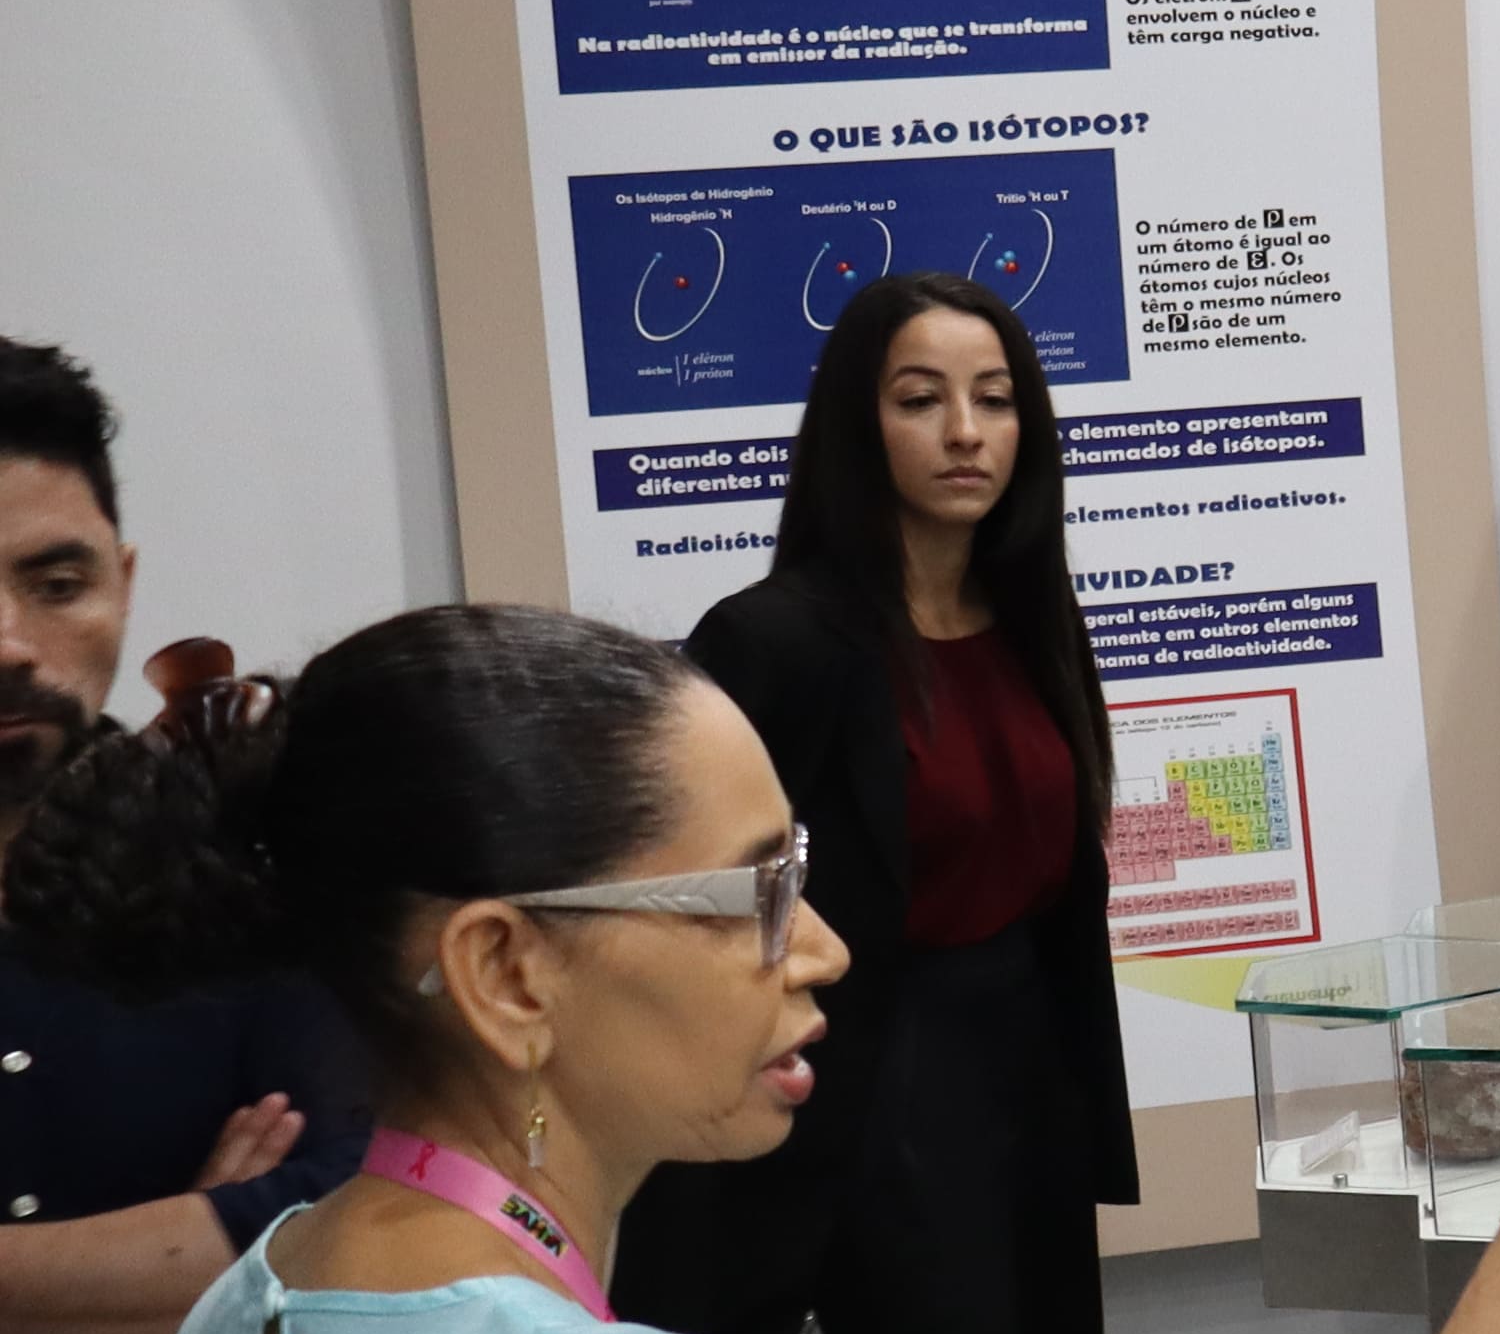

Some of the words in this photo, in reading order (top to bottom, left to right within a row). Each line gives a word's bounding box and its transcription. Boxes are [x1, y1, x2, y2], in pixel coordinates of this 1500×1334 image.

[1126, 8, 1217, 25] envolvem
[1223, 10, 1234, 21] o
[1240, 3, 1300, 20] núcleo
[1305, 6, 1316, 18] e
[577, 36, 612, 53] Na
[617, 29, 783, 52] radioatividade
[787, 27, 801, 44] é
[805, 30, 819, 43] o
[823, 24, 894, 42] núcleo
[898, 25, 939, 41] que
[943, 24, 965, 38] se
[968, 16, 1087, 36] transforma
[1127, 28, 1164, 45] têm
[1170, 30, 1224, 44] carga
[1229, 23, 1319, 42] negativa.
[707, 52, 741, 65] em
[746, 46, 826, 64] emissor
[830, 43, 860, 60] da
[864, 39, 967, 59] radiação.
[772, 129, 799, 152] O
[808, 125, 882, 153] QUE
[891, 118, 958, 147] SÃO
[968, 111, 1149, 142] ISÓTOPOS?
[615, 193, 633, 205] Os
[634, 192, 688, 204] Isótopos
[689, 189, 706, 201] de
[707, 185, 774, 200] Hidrogênio
[650, 209, 717, 224] Hidrogênio
[800, 202, 852, 215] Deutério
[1135, 219, 1151, 235] O
[1156, 218, 1229, 234] número
[1234, 214, 1257, 230] de
[1288, 215, 1316, 227] em
[1136, 243, 1167, 255] um
[1173, 237, 1234, 253] átomo
[1239, 235, 1249, 249] é
[1255, 232, 1302, 252] igual
[1308, 233, 1331, 245] ao
[1138, 258, 1210, 275] número
[1215, 254, 1238, 270] de
[1280, 250, 1303, 266] Os
[1139, 278, 1207, 294] átomos
[1213, 273, 1258, 291] cujos
[1263, 269, 1330, 286] núcleos
[1140, 297, 1177, 314] têm
[1182, 300, 1194, 311] o
[1199, 295, 1265, 310] mesmo
[1270, 289, 1341, 306] número
[1141, 317, 1165, 333] de
[1191, 315, 1222, 330] são
[1227, 312, 1250, 328] de
[1255, 314, 1285, 326] um
[1143, 338, 1209, 353] mesmo
[1214, 330, 1306, 348] elemento.
[1068, 418, 1180, 441] elemento
[1185, 410, 1328, 435] apresentam
[1186, 438, 1217, 456] de
[1222, 434, 1325, 454] isótopos.
[628, 448, 732, 474] Quando
[738, 445, 788, 464] dois
[636, 473, 762, 496] diferentes
[1064, 501, 1190, 524] elementos
[1197, 490, 1346, 514] radioativos.
[635, 530, 777, 557] Radioisóto
[1075, 562, 1235, 593] IVIDADE?
[1085, 607, 1134, 629] geral
[1138, 602, 1221, 623] estáveis,
[1224, 596, 1287, 618] porém
[1291, 593, 1354, 611] alguns
[1164, 628, 1195, 642] em
[1199, 622, 1259, 639] outros
[1263, 613, 1358, 633] elementos
[1153, 647, 1178, 664] de
[1183, 636, 1332, 661] radioatividade.
